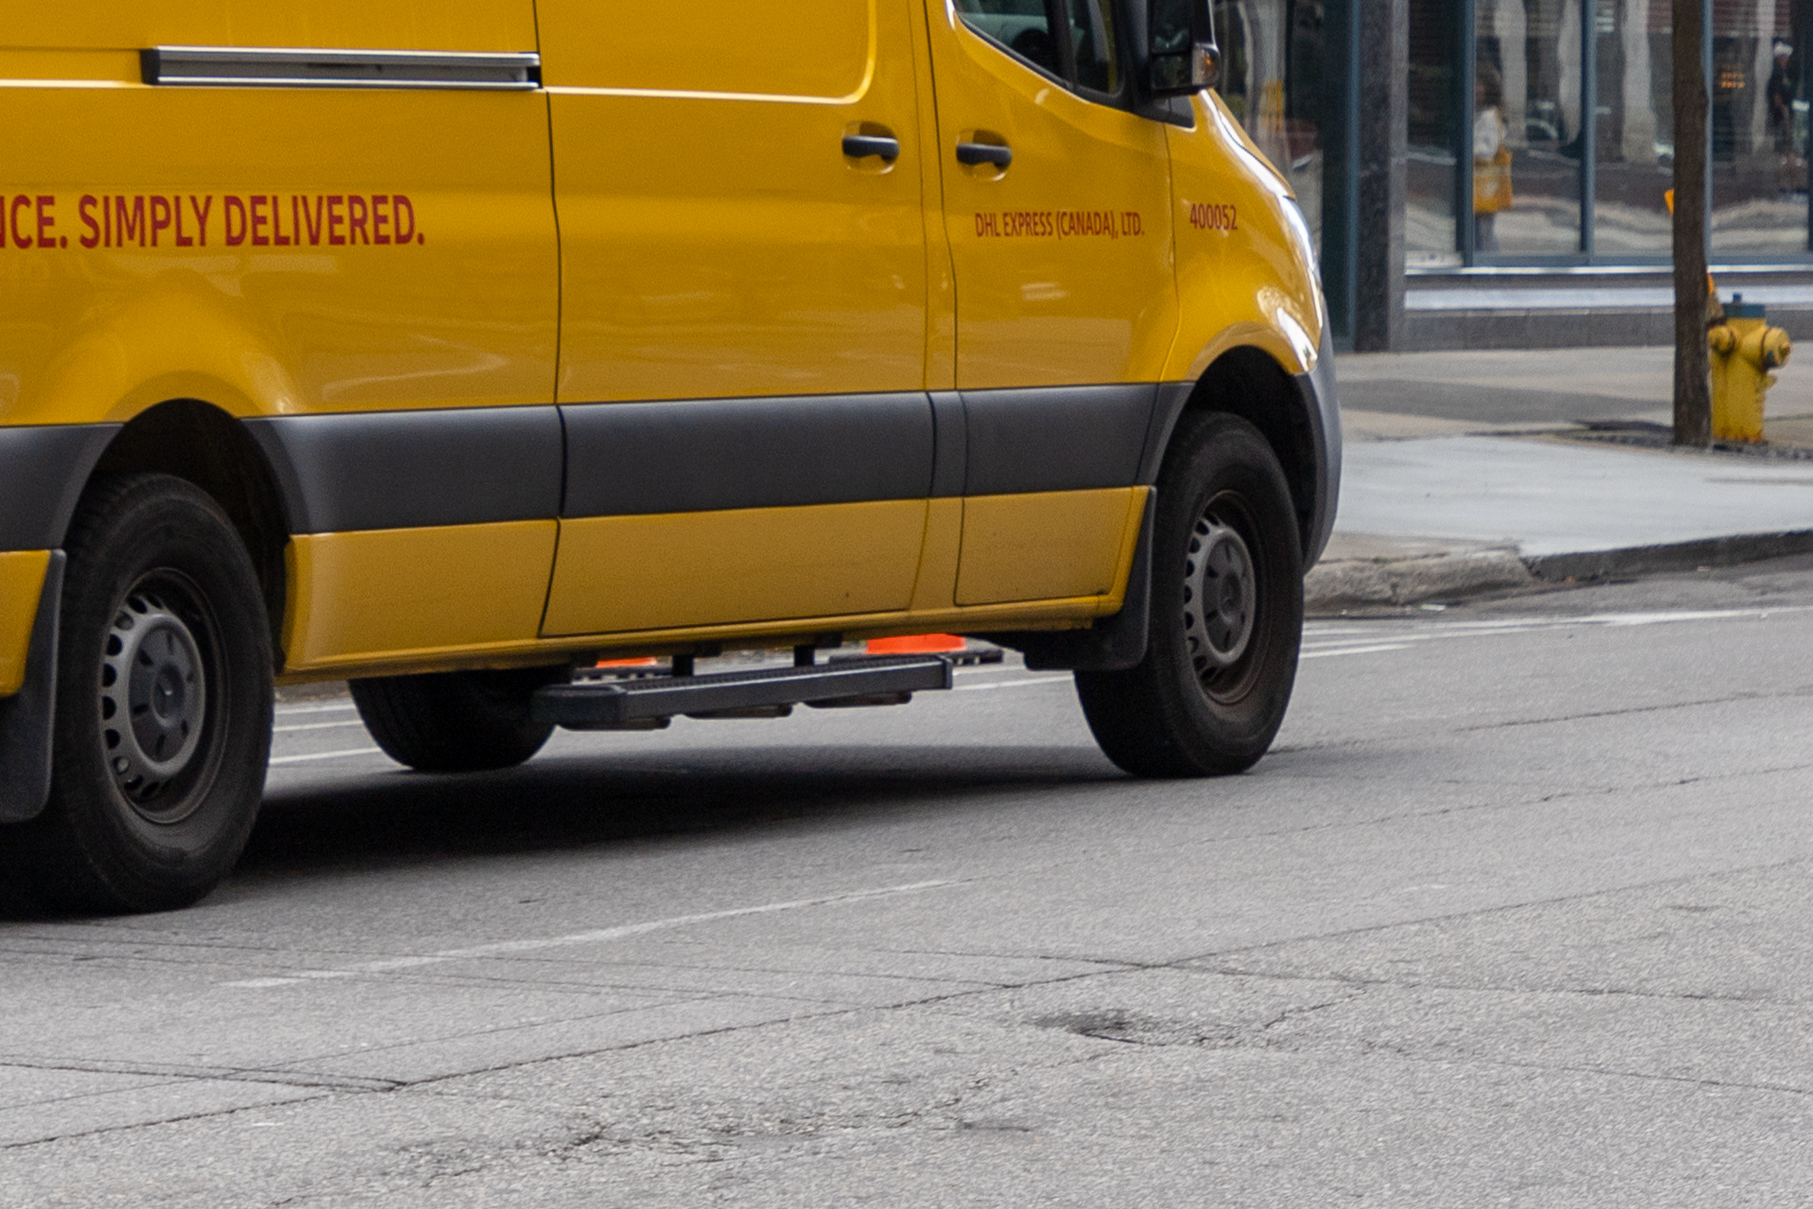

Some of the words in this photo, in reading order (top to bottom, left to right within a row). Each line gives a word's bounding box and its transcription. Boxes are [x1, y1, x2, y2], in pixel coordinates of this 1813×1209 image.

[78, 194, 213, 248] SIMPLY
[223, 194, 425, 246] DELIVERED.
[974, 211, 999, 238] DHL
[1002, 211, 1054, 237] EXPRESS
[1121, 210, 1145, 236] LTD.
[1189, 202, 1238, 232] 400052
